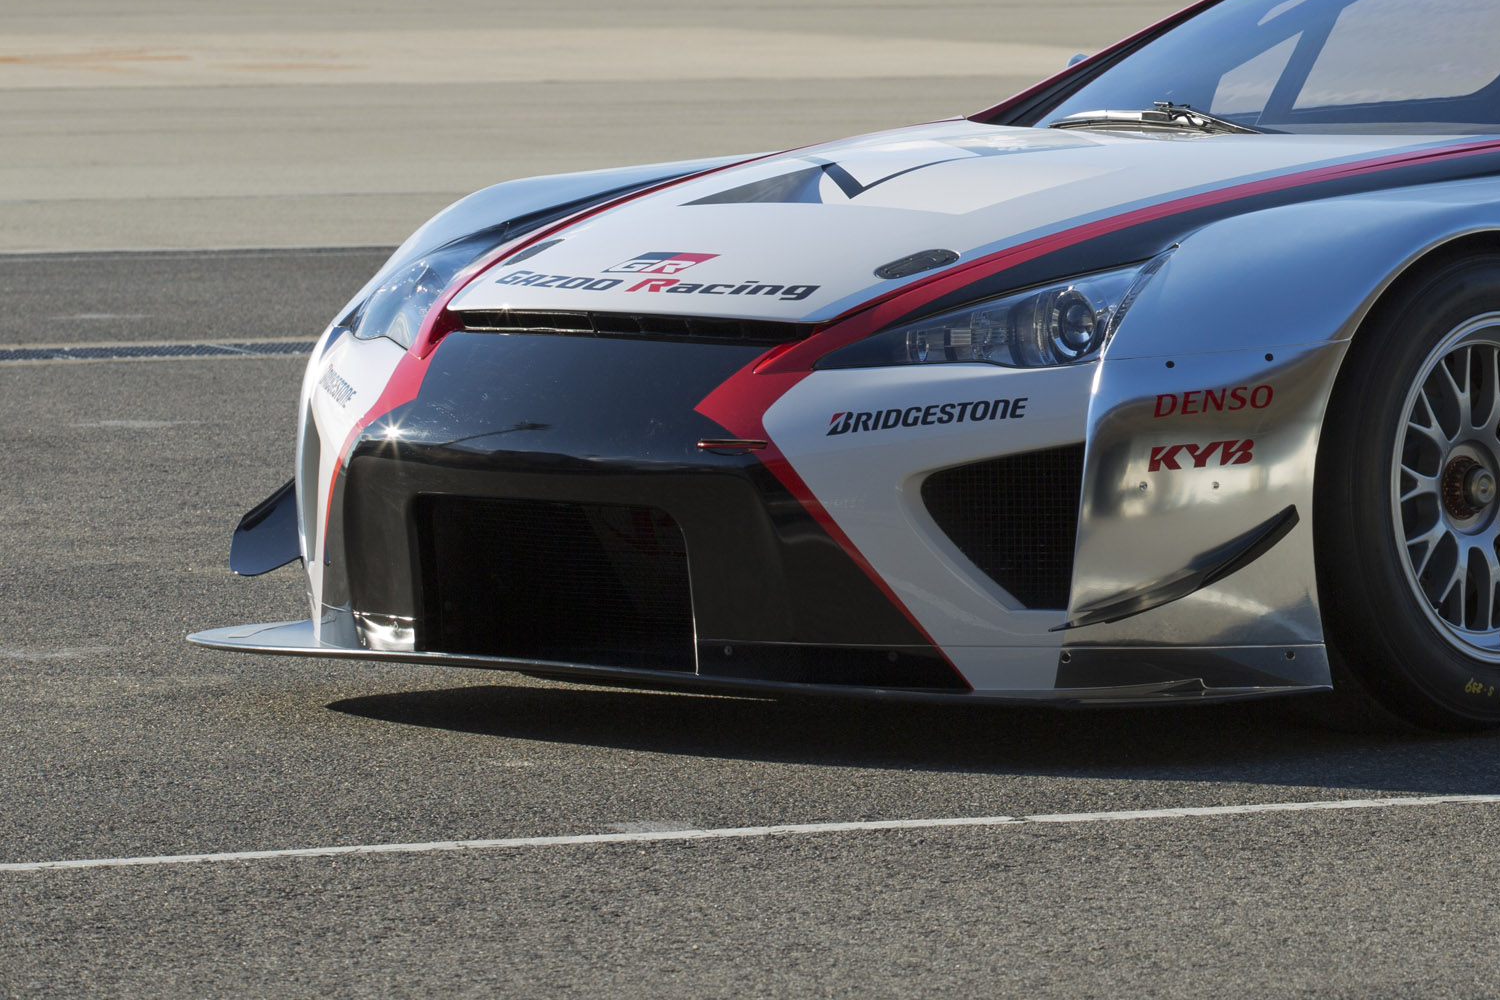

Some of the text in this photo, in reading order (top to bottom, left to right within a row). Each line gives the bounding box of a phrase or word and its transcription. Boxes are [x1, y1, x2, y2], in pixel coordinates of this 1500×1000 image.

[607, 259, 697, 273] GR
[495, 270, 822, 301] GAZOO Racing
[825, 397, 1029, 436] BRIDGESTONE
[1153, 384, 1274, 418] DENSO
[1147, 438, 1255, 473] KYB
